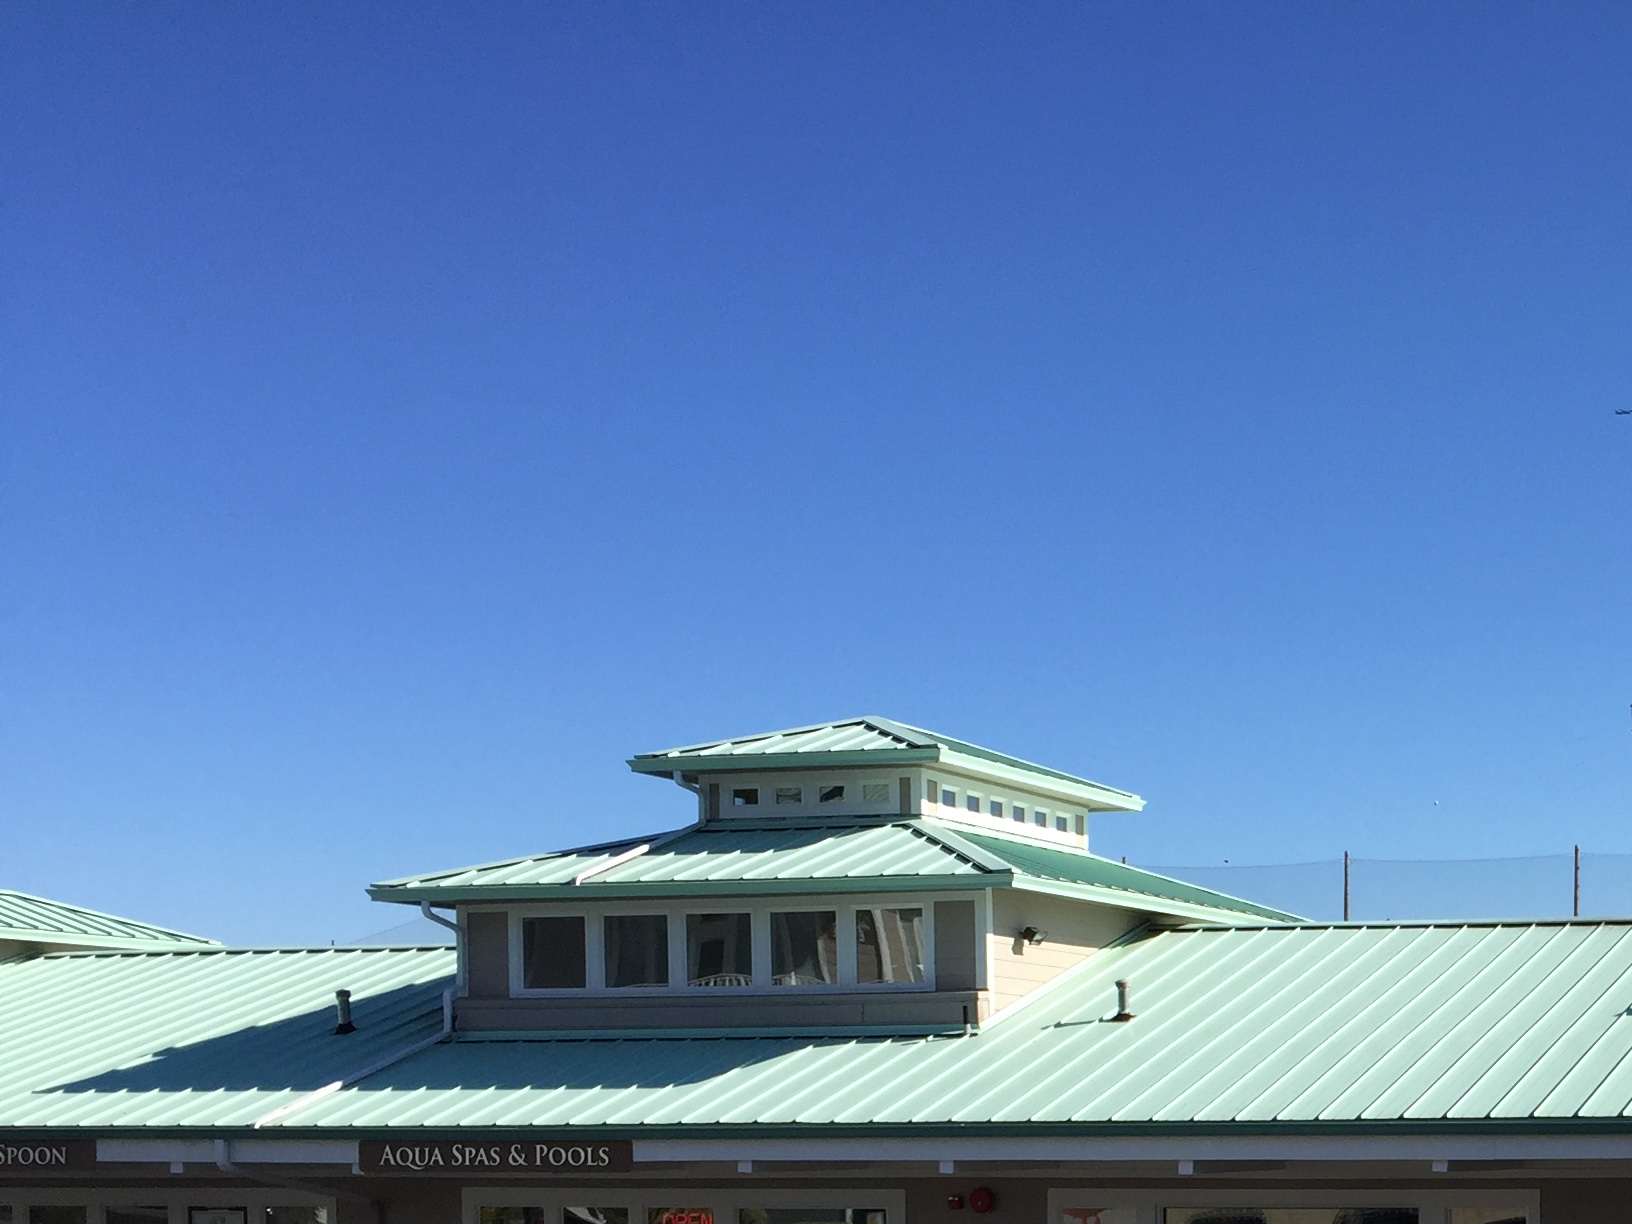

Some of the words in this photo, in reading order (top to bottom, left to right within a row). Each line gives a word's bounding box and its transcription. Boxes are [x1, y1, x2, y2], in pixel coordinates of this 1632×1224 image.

[0, 1143, 67, 1165] SPOON
[379, 1144, 445, 1170] AQUA
[451, 1144, 500, 1166] SPAS
[508, 1144, 528, 1166] &
[534, 1144, 610, 1166] POOLS
